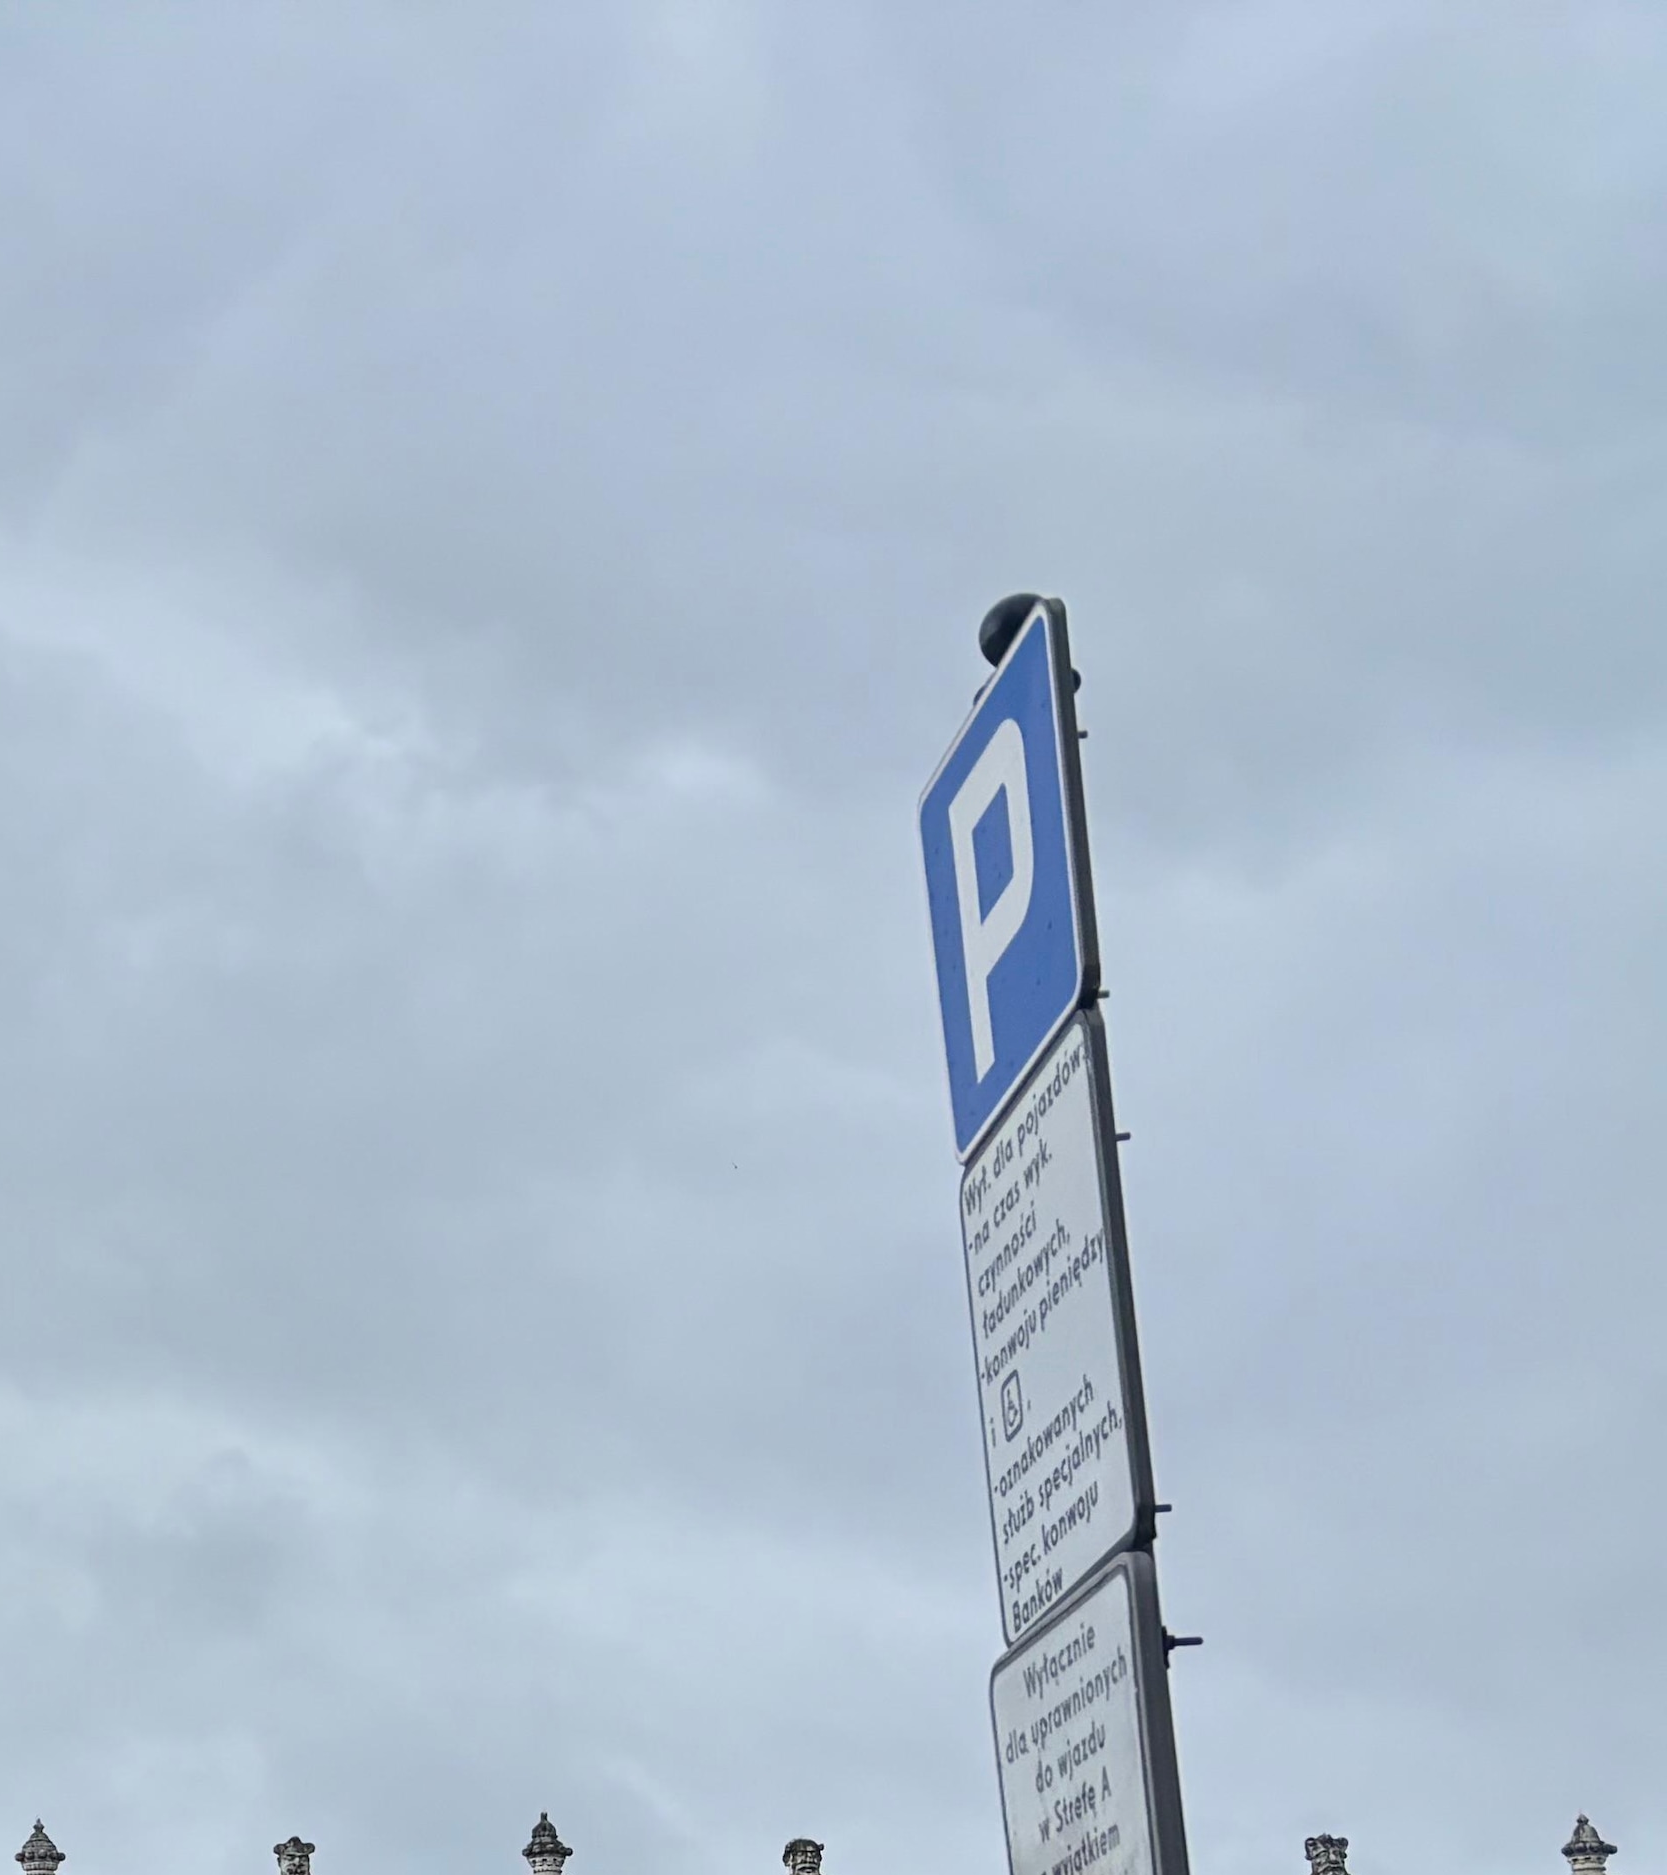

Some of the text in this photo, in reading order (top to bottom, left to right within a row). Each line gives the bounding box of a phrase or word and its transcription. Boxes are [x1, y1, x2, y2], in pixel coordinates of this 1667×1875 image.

[948, 717, 1035, 1085] P
[964, 1165, 991, 1216] Wył.
[993, 1139, 1013, 1179] dla
[993, 1180, 1020, 1228] czas
[1024, 1138, 1052, 1189] wyk.
[978, 1200, 1036, 1297] czynności
[982, 1218, 1070, 1339] ładunkowych,
[1039, 1228, 1104, 1333] pieniędzy
[1003, 1399, 1122, 1545] służb specjalnych,
[1041, 1480, 1098, 1555] konwoju
[1012, 1567, 1064, 1634] Banków
[1006, 1645, 1127, 1764] dla uprawnionych
[1022, 1622, 1095, 1699] Wyłącznie
[1035, 1719, 1106, 1793] do wjazdu
[1038, 1765, 1112, 1843] w Strefę A
